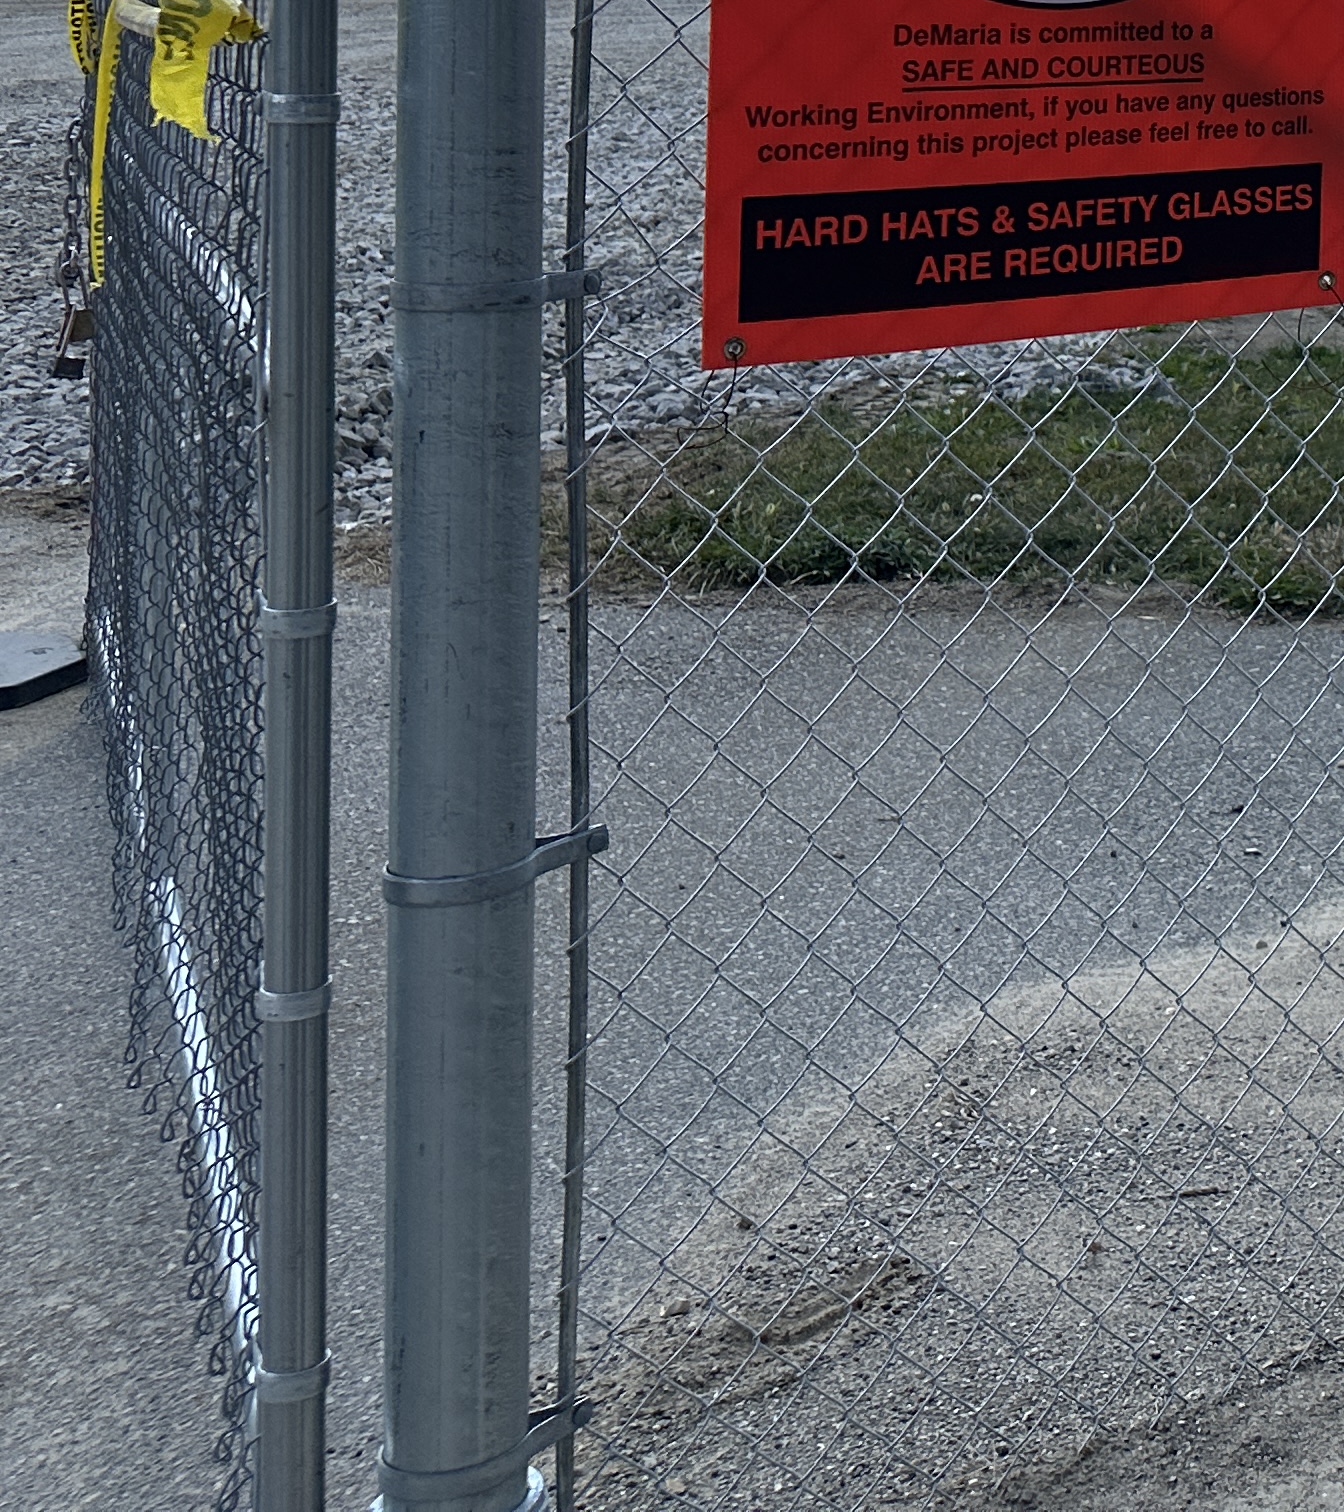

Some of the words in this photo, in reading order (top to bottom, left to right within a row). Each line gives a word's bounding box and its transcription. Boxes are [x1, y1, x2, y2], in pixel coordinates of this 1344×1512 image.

[894, 24, 1000, 46] DeMaria
[1010, 24, 1030, 44] is
[1039, 21, 1164, 43] committed
[1172, 23, 1193, 40] to
[1200, 24, 1213, 39] a
[902, 60, 973, 82] SAFE
[982, 58, 1039, 80] AND
[1047, 53, 1204, 78] COURTEOUS
[746, 104, 857, 130] Working
[868, 98, 1035, 123] Environment,
[1044, 96, 1058, 116] if
[1065, 98, 1107, 121] you
[1116, 94, 1169, 113] have
[1176, 94, 1216, 114] any
[1222, 87, 1324, 113] questions
[758, 136, 908, 162] concerning
[917, 132, 964, 155] this
[972, 126, 1057, 157] project
[1065, 126, 1141, 152] please
[1149, 122, 1189, 143] feel
[1197, 120, 1238, 139] free
[1245, 119, 1265, 137] to
[1272, 116, 1313, 136] call.
[757, 214, 868, 250] HARD
[882, 207, 979, 241] HATS
[992, 205, 1015, 234] &
[1027, 194, 1159, 231] SAFETY
[1167, 184, 1313, 220] GLASSES
[916, 250, 992, 285] ARE
[1004, 236, 1183, 278] REQUIRED
